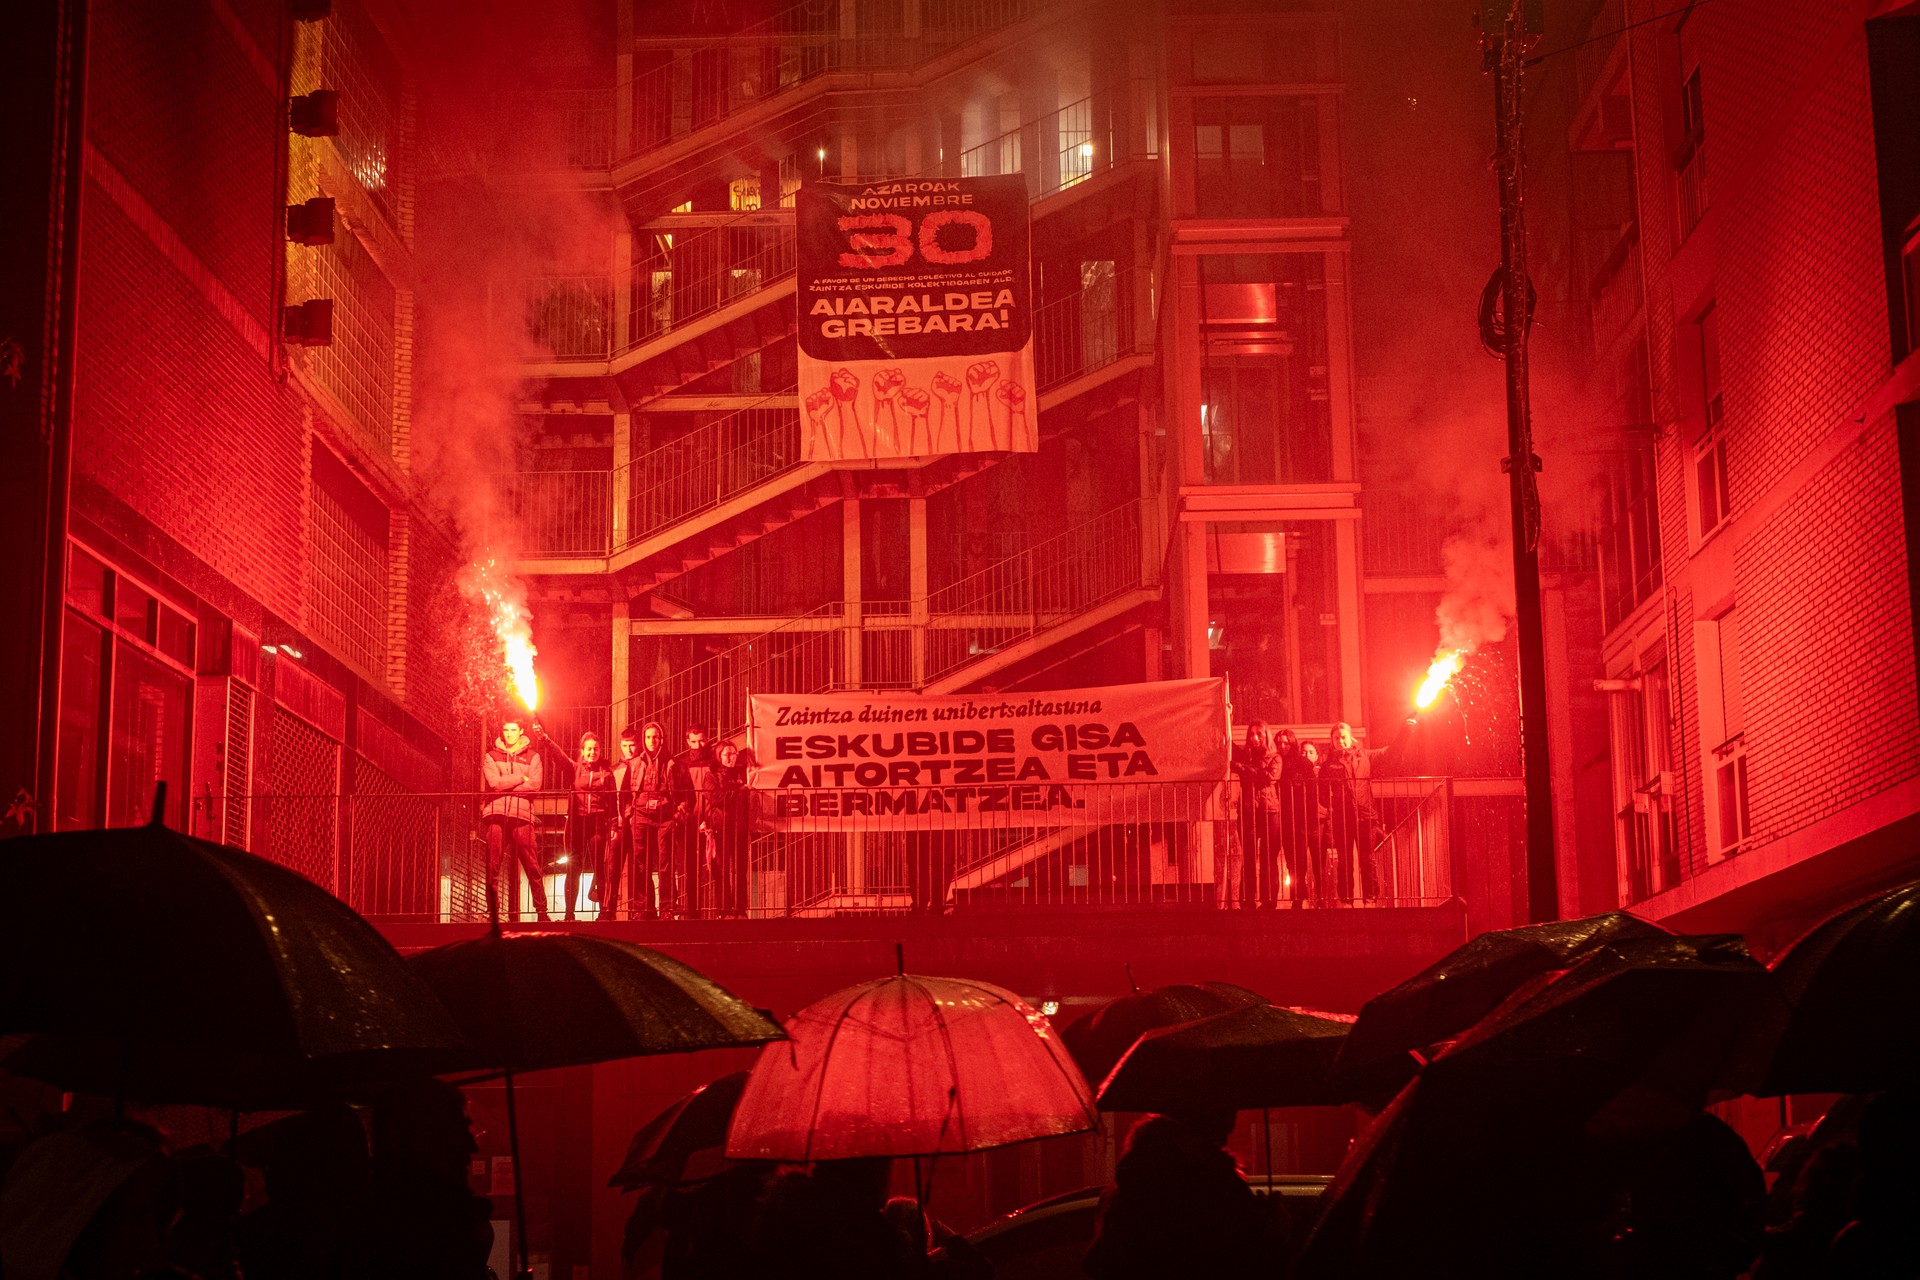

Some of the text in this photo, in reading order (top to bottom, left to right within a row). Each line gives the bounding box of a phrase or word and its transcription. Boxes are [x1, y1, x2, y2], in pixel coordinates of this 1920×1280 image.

[850, 194, 973, 210] NOVIEMBRE
[861, 182, 960, 196] AZAROAK
[837, 210, 993, 269] 30
[854, 282, 905, 290] ESKUBIDE
[993, 275, 1016, 283] ALD
[809, 289, 1016, 316] AIARALDEA
[820, 309, 1009, 339] GREBARA!
[775, 698, 1103, 727] Zaintza duinen unibertsaltasuna
[775, 722, 1147, 760] ESKUBIDE GISA
[778, 750, 1159, 788] AITORTZEA ETA
[776, 784, 1086, 818] BERMATZEA.
